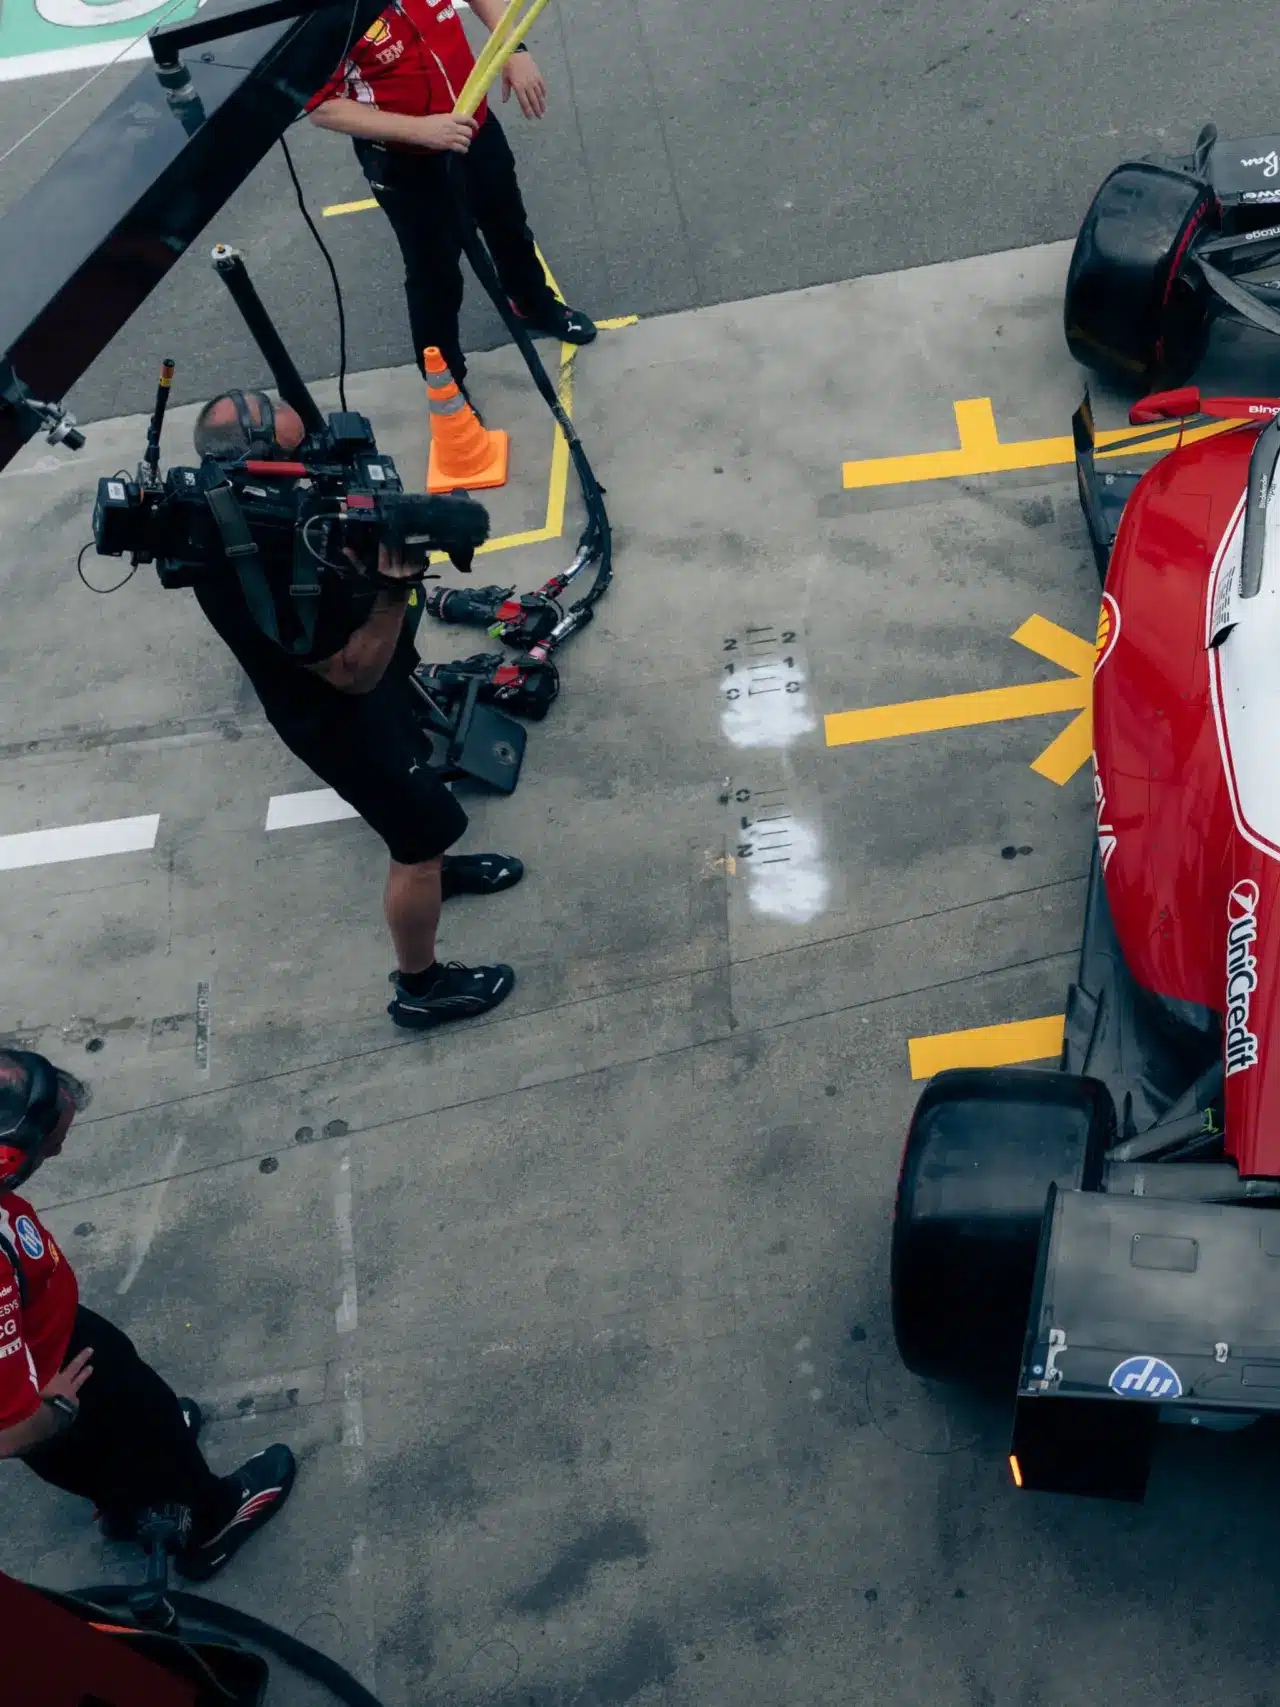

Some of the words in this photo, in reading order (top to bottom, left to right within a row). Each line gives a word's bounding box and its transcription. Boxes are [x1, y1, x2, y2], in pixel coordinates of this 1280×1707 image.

[375, 40, 405, 65] IBM
[1258, 473, 1268, 509] Bitdefender
[724, 638, 738, 652] 2
[782, 631, 797, 645] 2
[724, 663, 735, 675] 1
[783, 655, 795, 669] 1
[725, 687, 740, 701] 0
[785, 681, 800, 694] 0
[735, 788, 751, 802] 0
[1225, 915, 1259, 1078] UniCredit
[1120, 1357, 1174, 1397] hp
